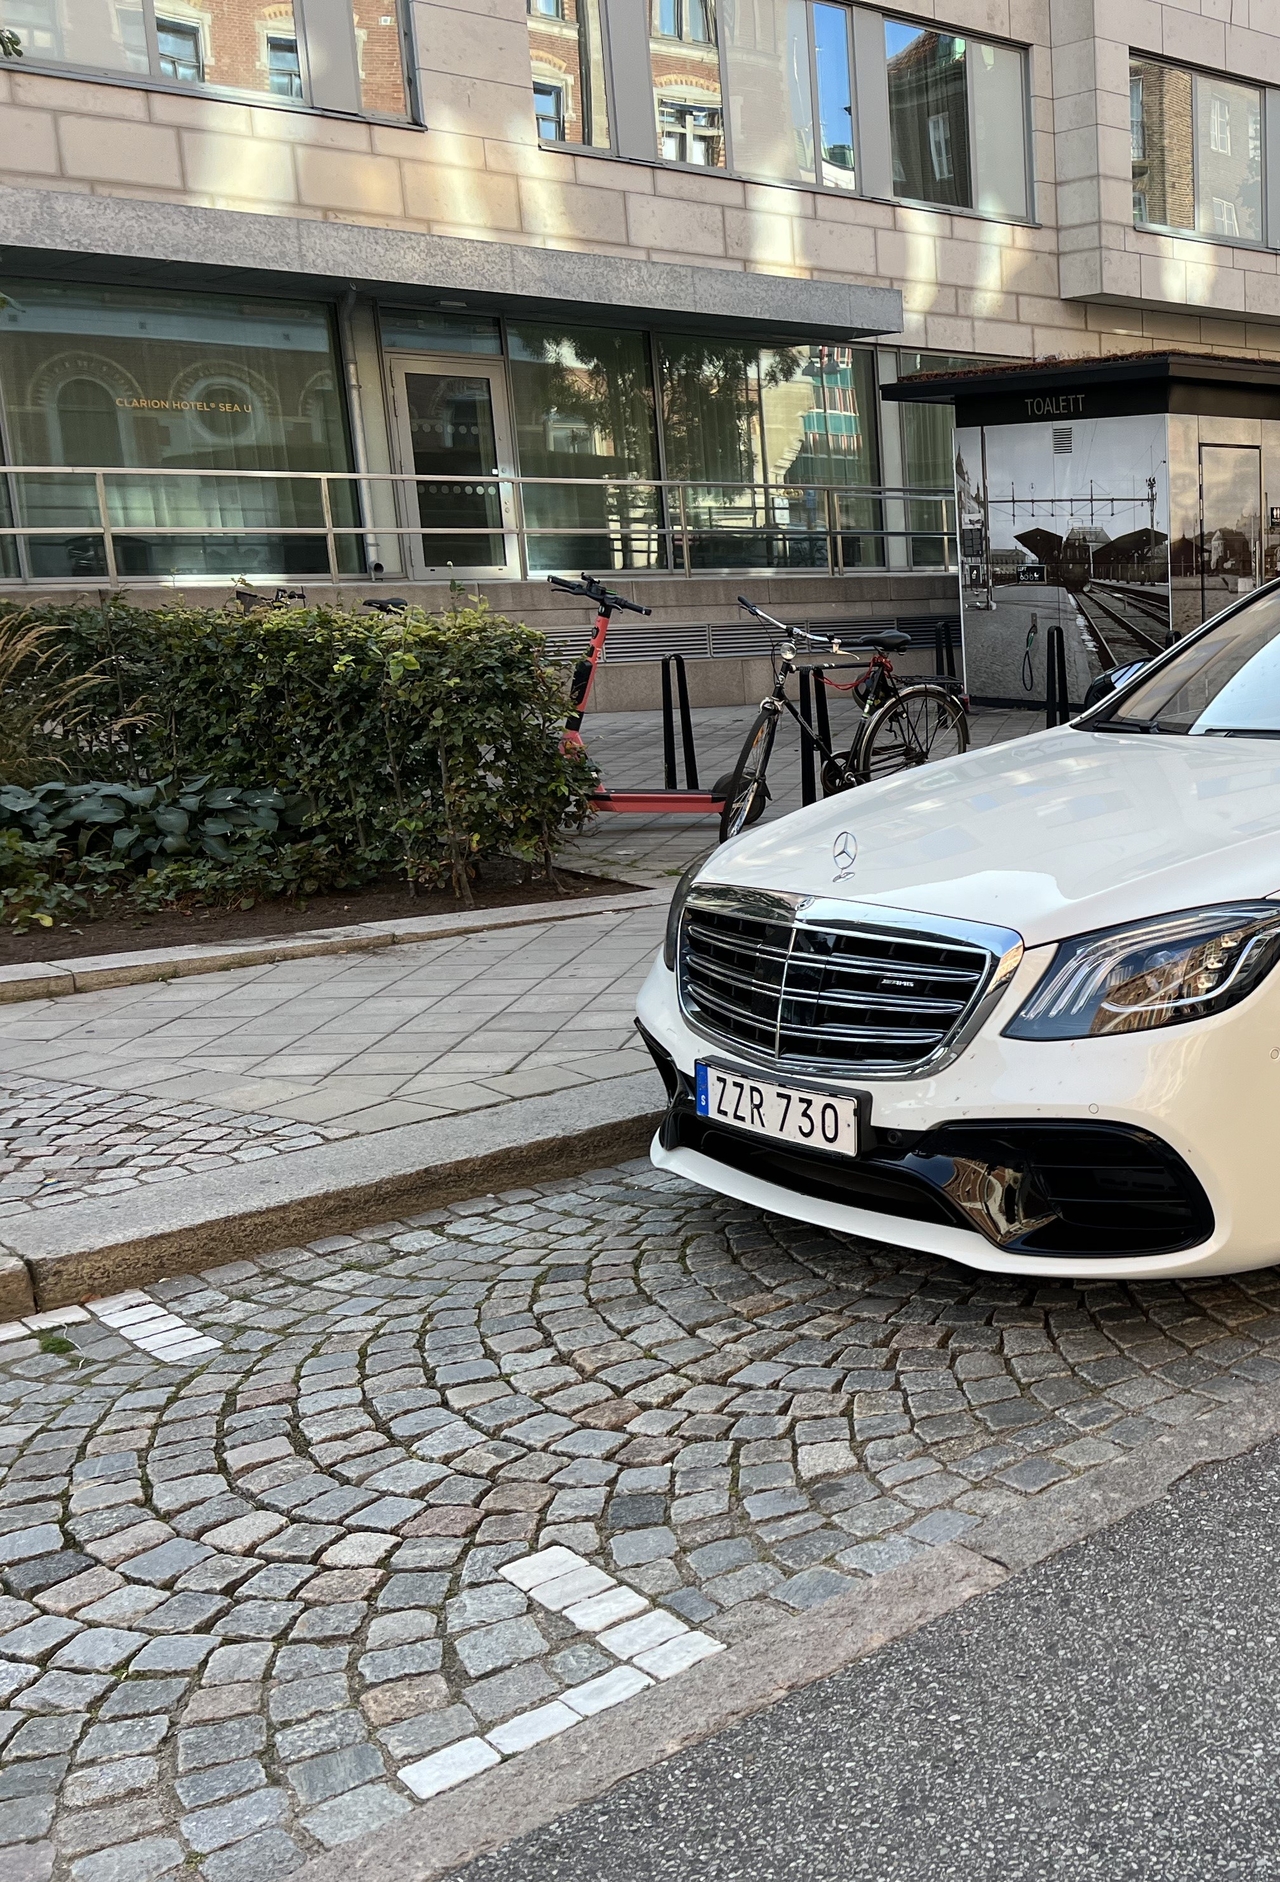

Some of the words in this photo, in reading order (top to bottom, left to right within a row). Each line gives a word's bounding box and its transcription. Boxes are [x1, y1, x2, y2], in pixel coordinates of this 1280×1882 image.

[115, 397, 169, 409] CLARION
[219, 402, 241, 412] SEA
[244, 404, 252, 413] U
[1024, 394, 1085, 416] TOALETT
[700, 1095, 706, 1106] S
[716, 1075, 766, 1128] ZZR
[775, 1091, 839, 1144] 730
